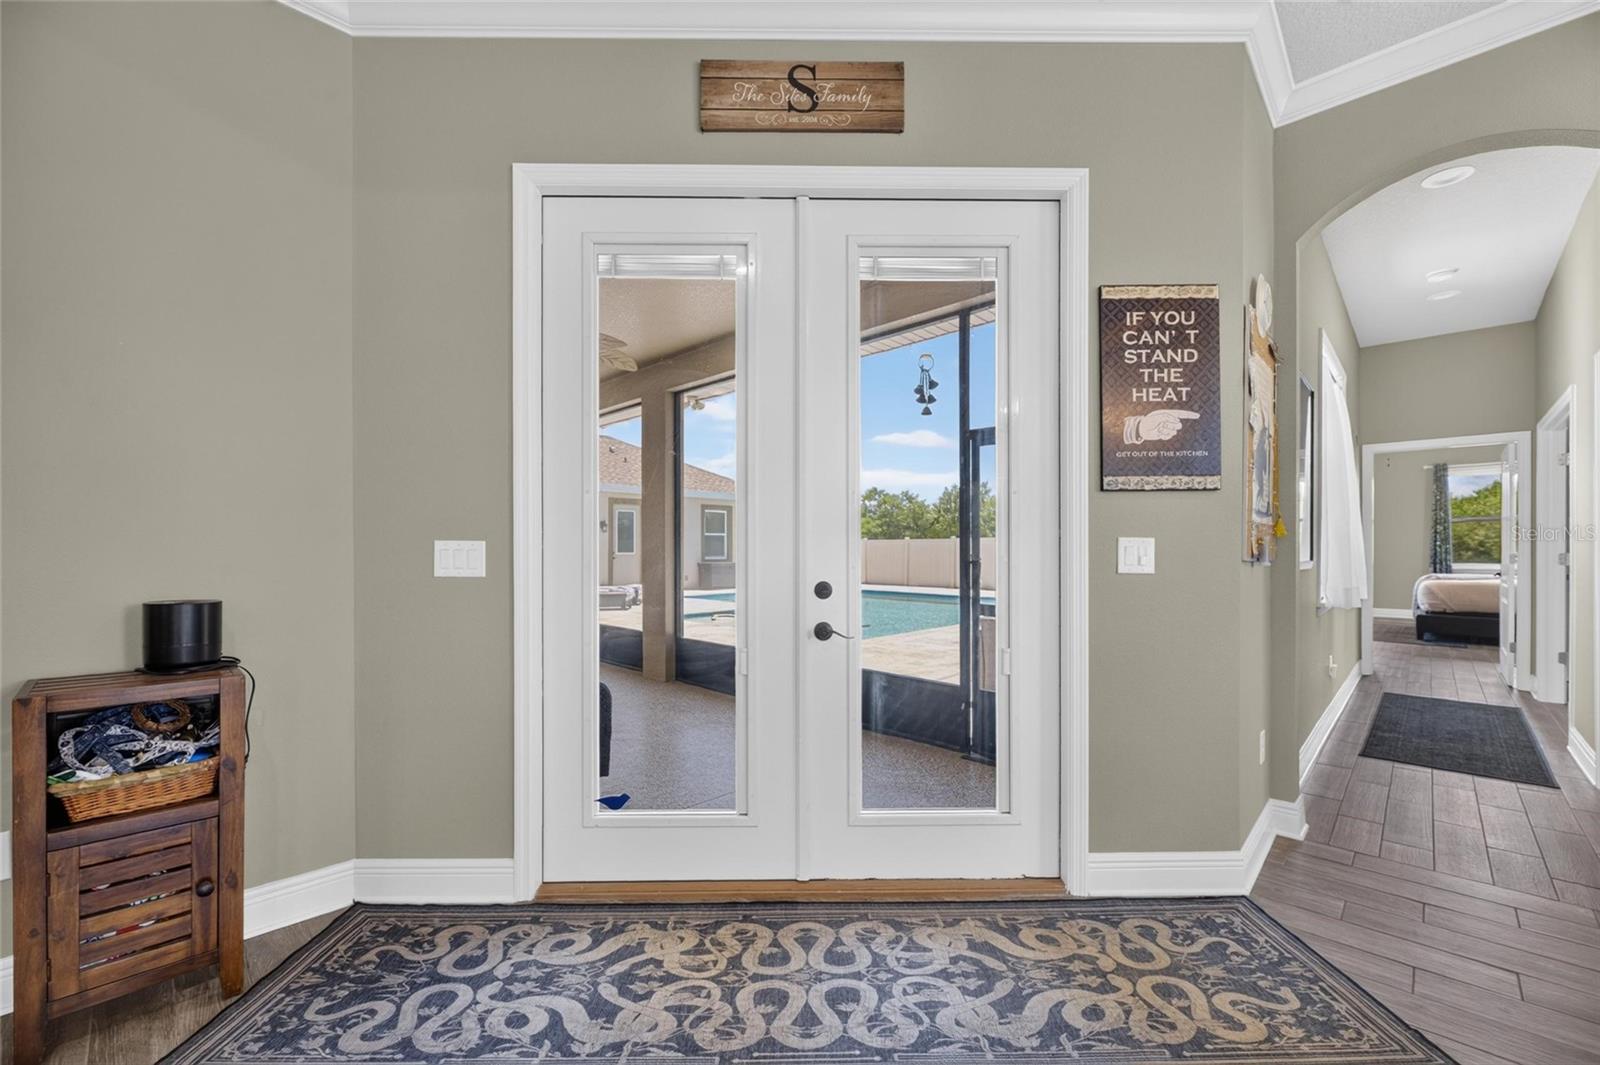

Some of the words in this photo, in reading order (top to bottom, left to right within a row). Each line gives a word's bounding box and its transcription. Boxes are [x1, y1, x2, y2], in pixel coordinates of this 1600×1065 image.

[788, 64, 819, 113] S
[732, 82, 764, 102] The
[814, 83, 872, 111] Family
[1126, 312, 1145, 325] IF
[1150, 311, 1195, 325] YOU
[1124, 349, 1198, 363] STAND
[1140, 368, 1183, 382] THE
[1132, 388, 1191, 401] HEAT
